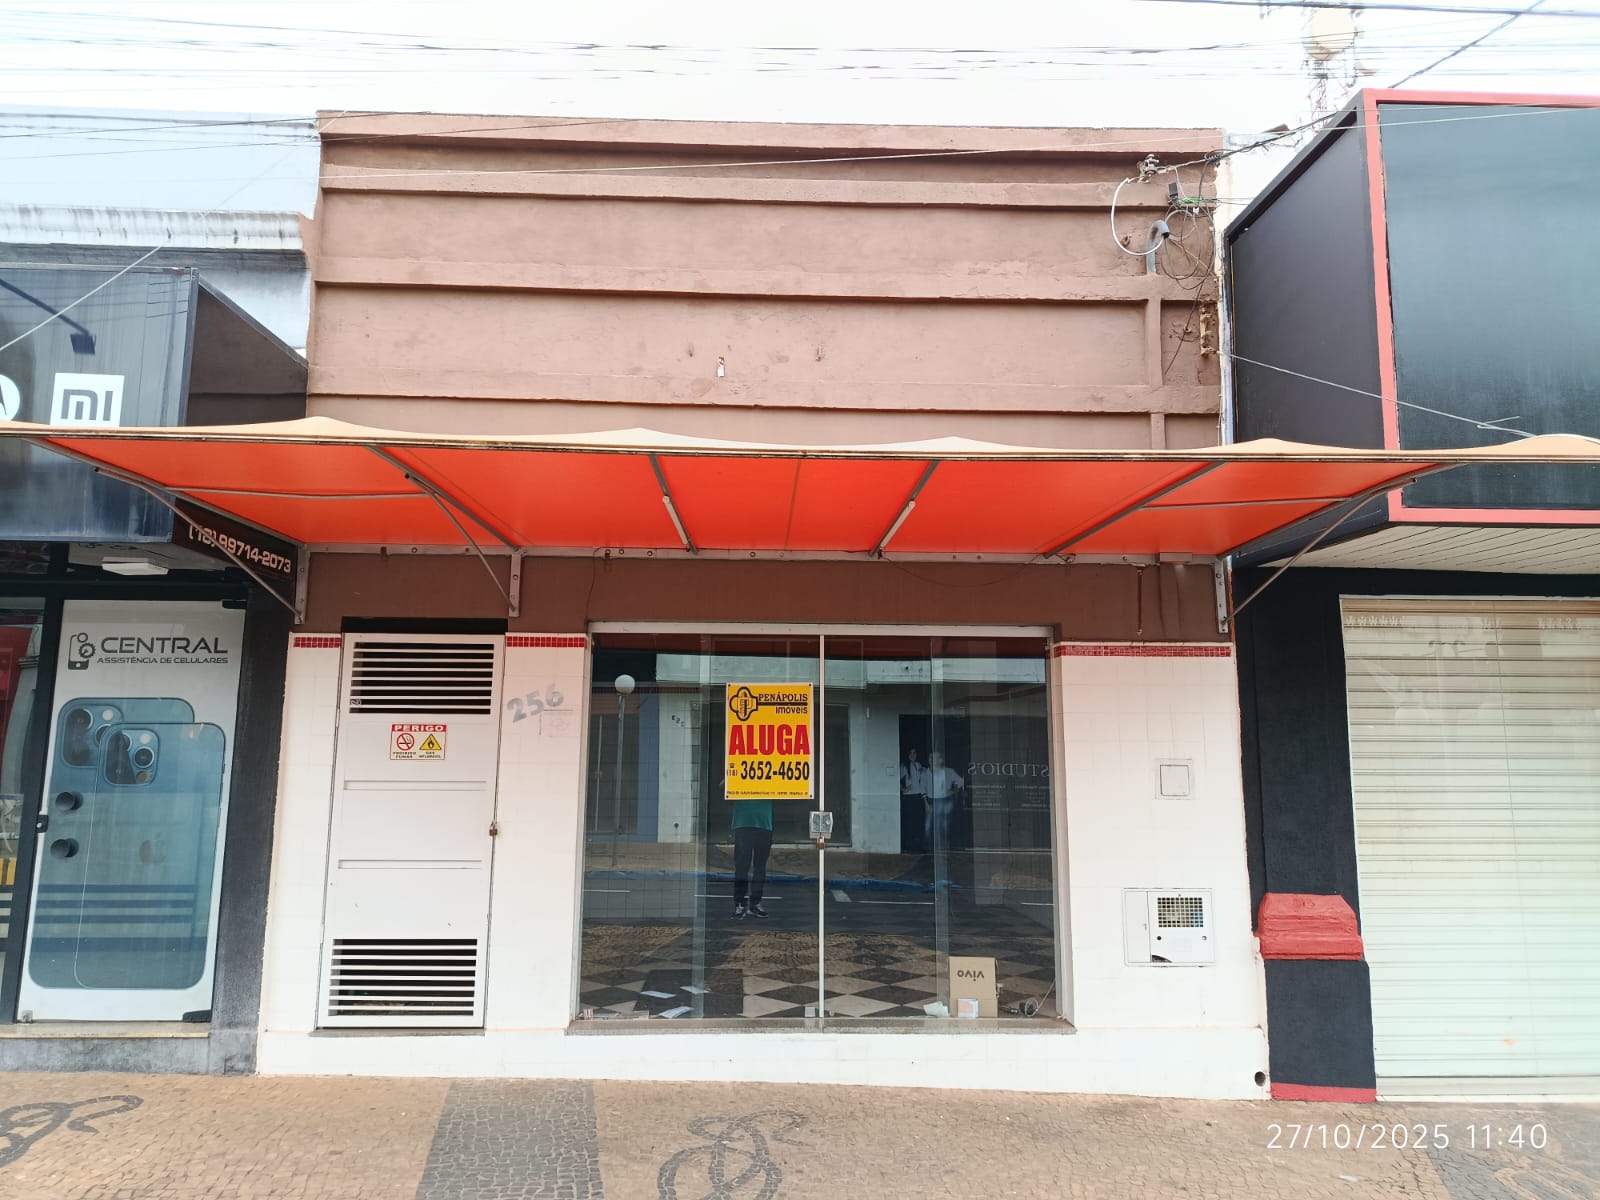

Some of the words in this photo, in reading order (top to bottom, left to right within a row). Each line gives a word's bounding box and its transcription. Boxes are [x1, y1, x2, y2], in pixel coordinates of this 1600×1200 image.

[101, 637, 228, 654] CENTRAL
[97, 656, 158, 664] ASSISTÊNCIA
[506, 683, 565, 723] 256
[758, 692, 808, 702] PENÁPOLIS
[728, 724, 811, 755] ALUGA
[740, 760, 810, 781] 3652-4650
[957, 969, 985, 981] vivo
